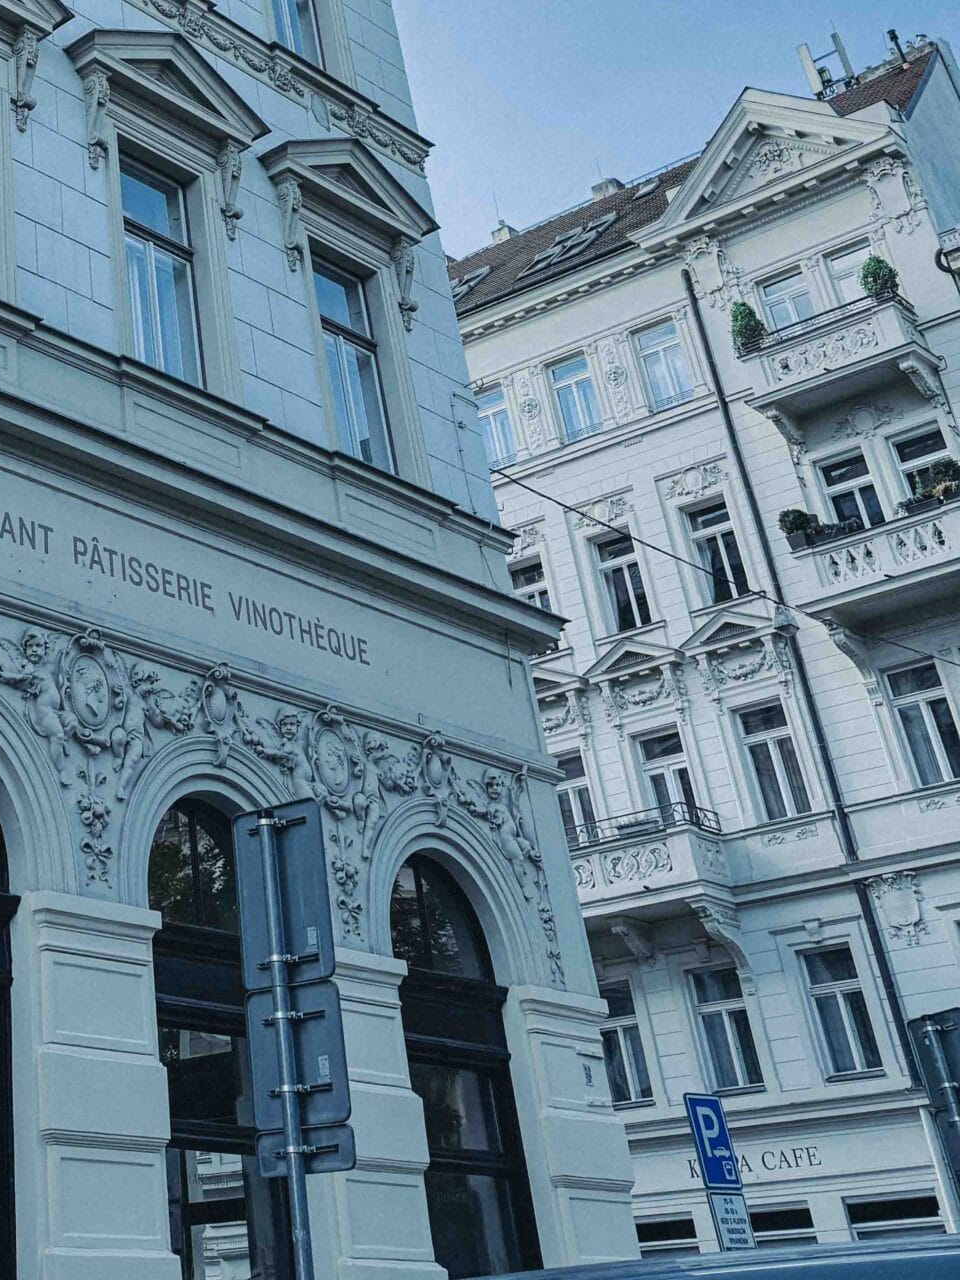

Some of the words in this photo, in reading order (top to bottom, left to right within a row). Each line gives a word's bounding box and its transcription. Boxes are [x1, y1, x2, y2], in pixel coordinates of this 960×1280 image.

[72, 536, 215, 612] PÂTISSERIE
[228, 591, 371, 666] VINOTHÈQUE
[695, 1106, 720, 1158] P
[761, 1146, 822, 1171] CAFE
